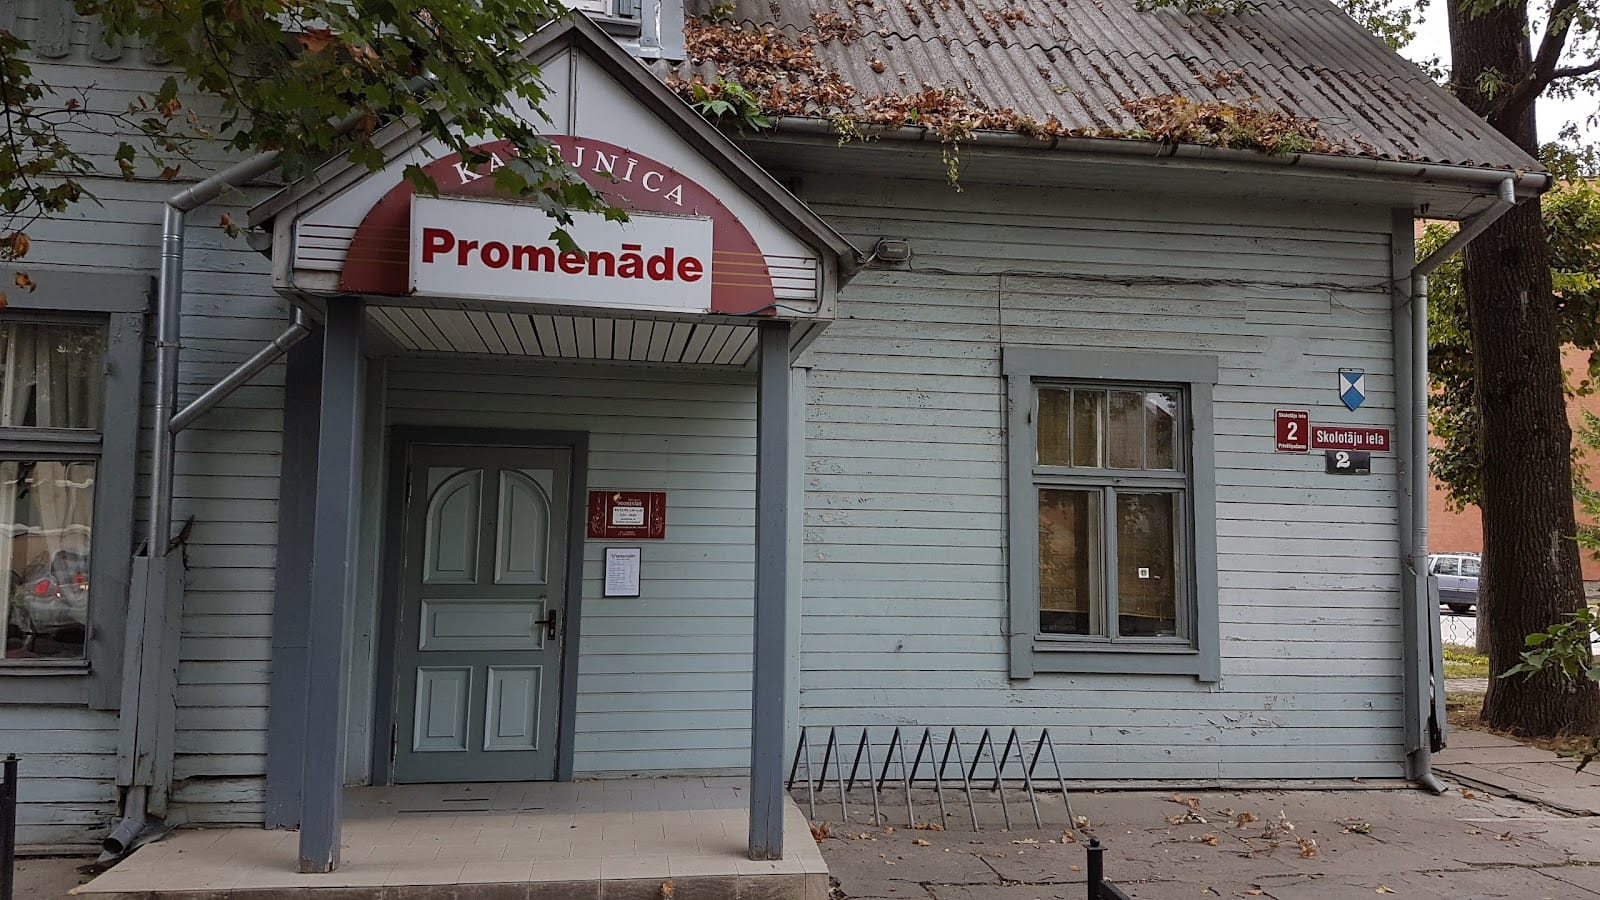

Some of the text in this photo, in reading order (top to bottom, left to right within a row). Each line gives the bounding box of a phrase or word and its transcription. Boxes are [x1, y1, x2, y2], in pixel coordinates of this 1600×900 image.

[452, 144, 684, 206] KAJNĪCA
[422, 227, 703, 283] Promenāde
[1287, 421, 1298, 441] 2
[1316, 430, 1384, 446] Skolotāju iela
[1335, 451, 1351, 468] 2
